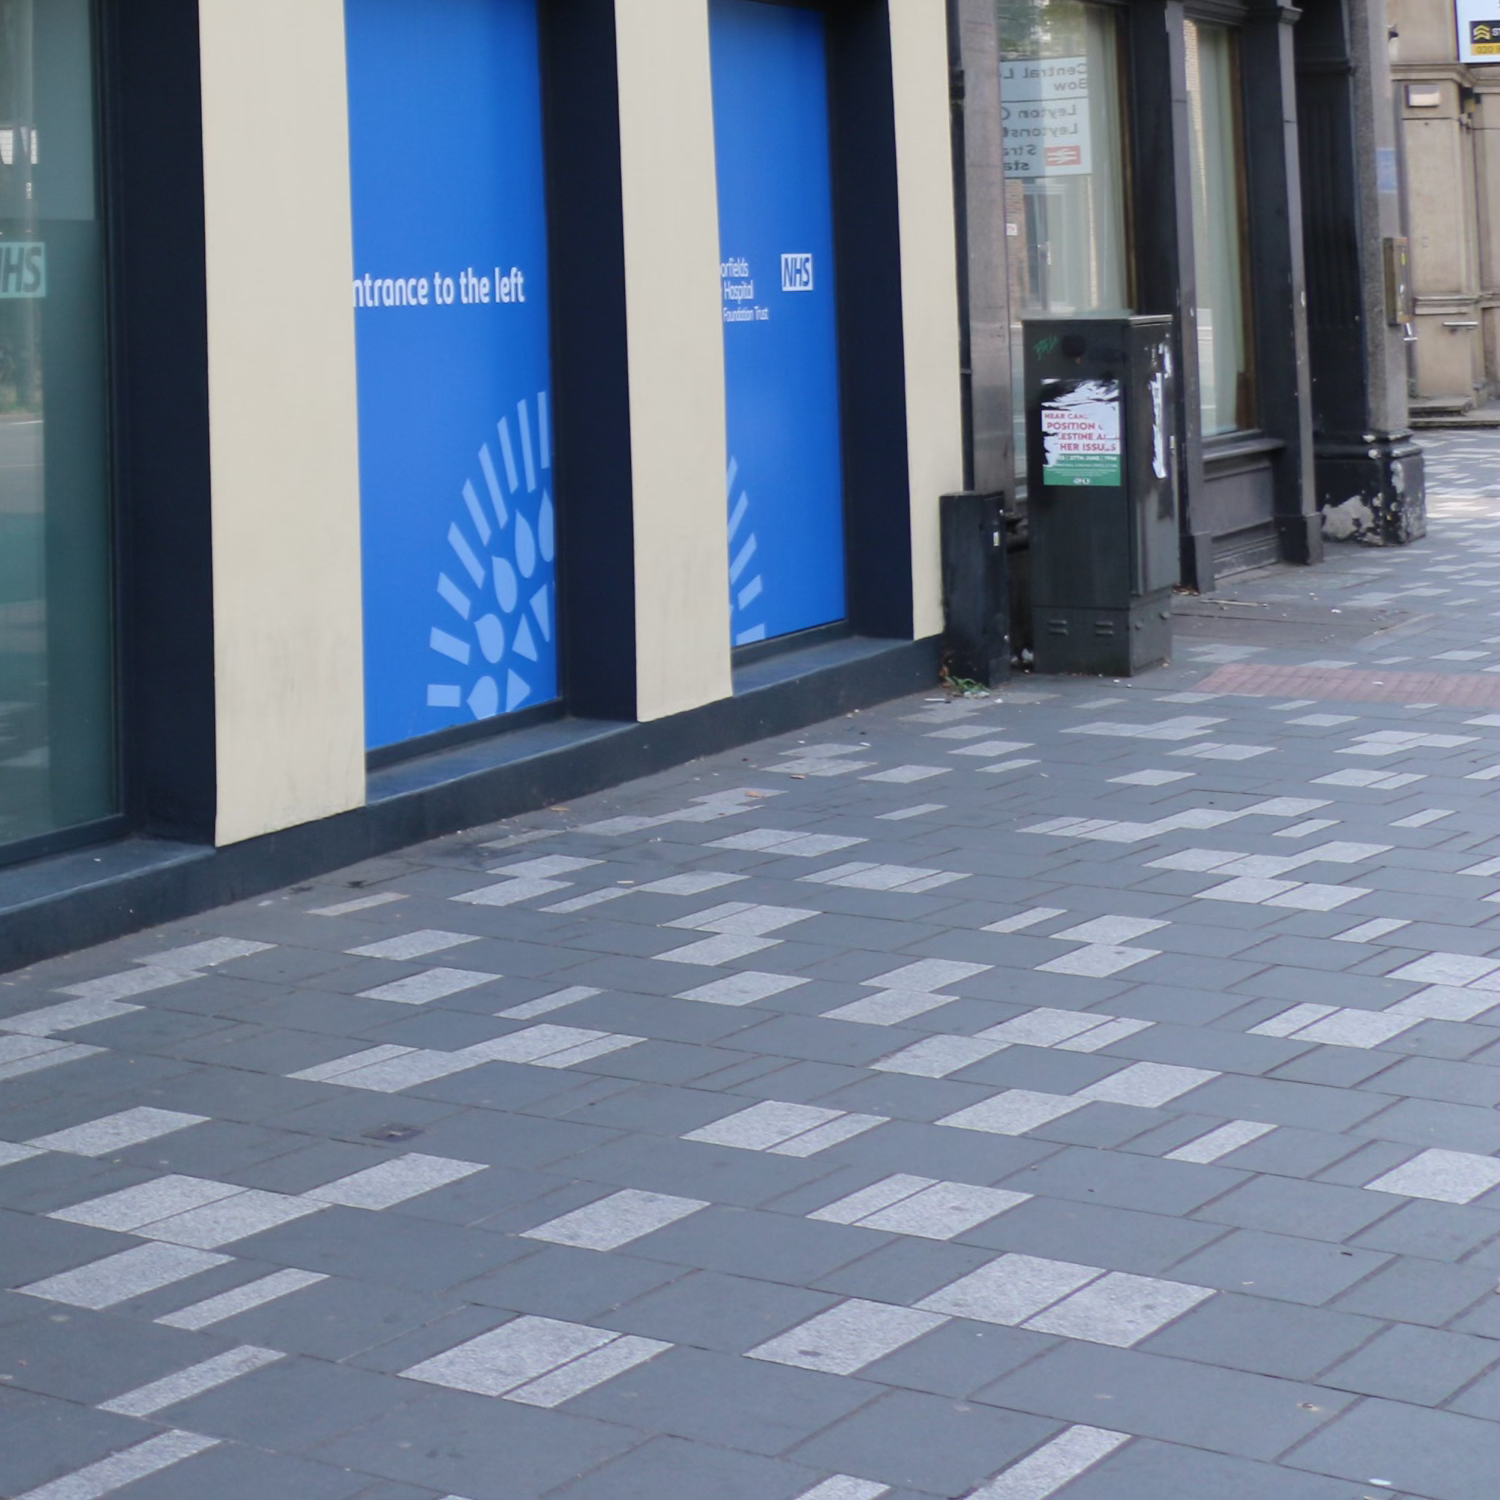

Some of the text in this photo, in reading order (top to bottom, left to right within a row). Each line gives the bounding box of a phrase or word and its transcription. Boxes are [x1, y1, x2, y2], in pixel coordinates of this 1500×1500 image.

[720, 257, 749, 278] orfields
[782, 255, 811, 290] NHS
[353, 266, 525, 308] ntrance to the left
[723, 280, 754, 304] Hospital
[723, 305, 769, 322] Foundation Trust
[1046, 422, 1096, 430] POSITION
[1082, 443, 1117, 451] ISSUS
